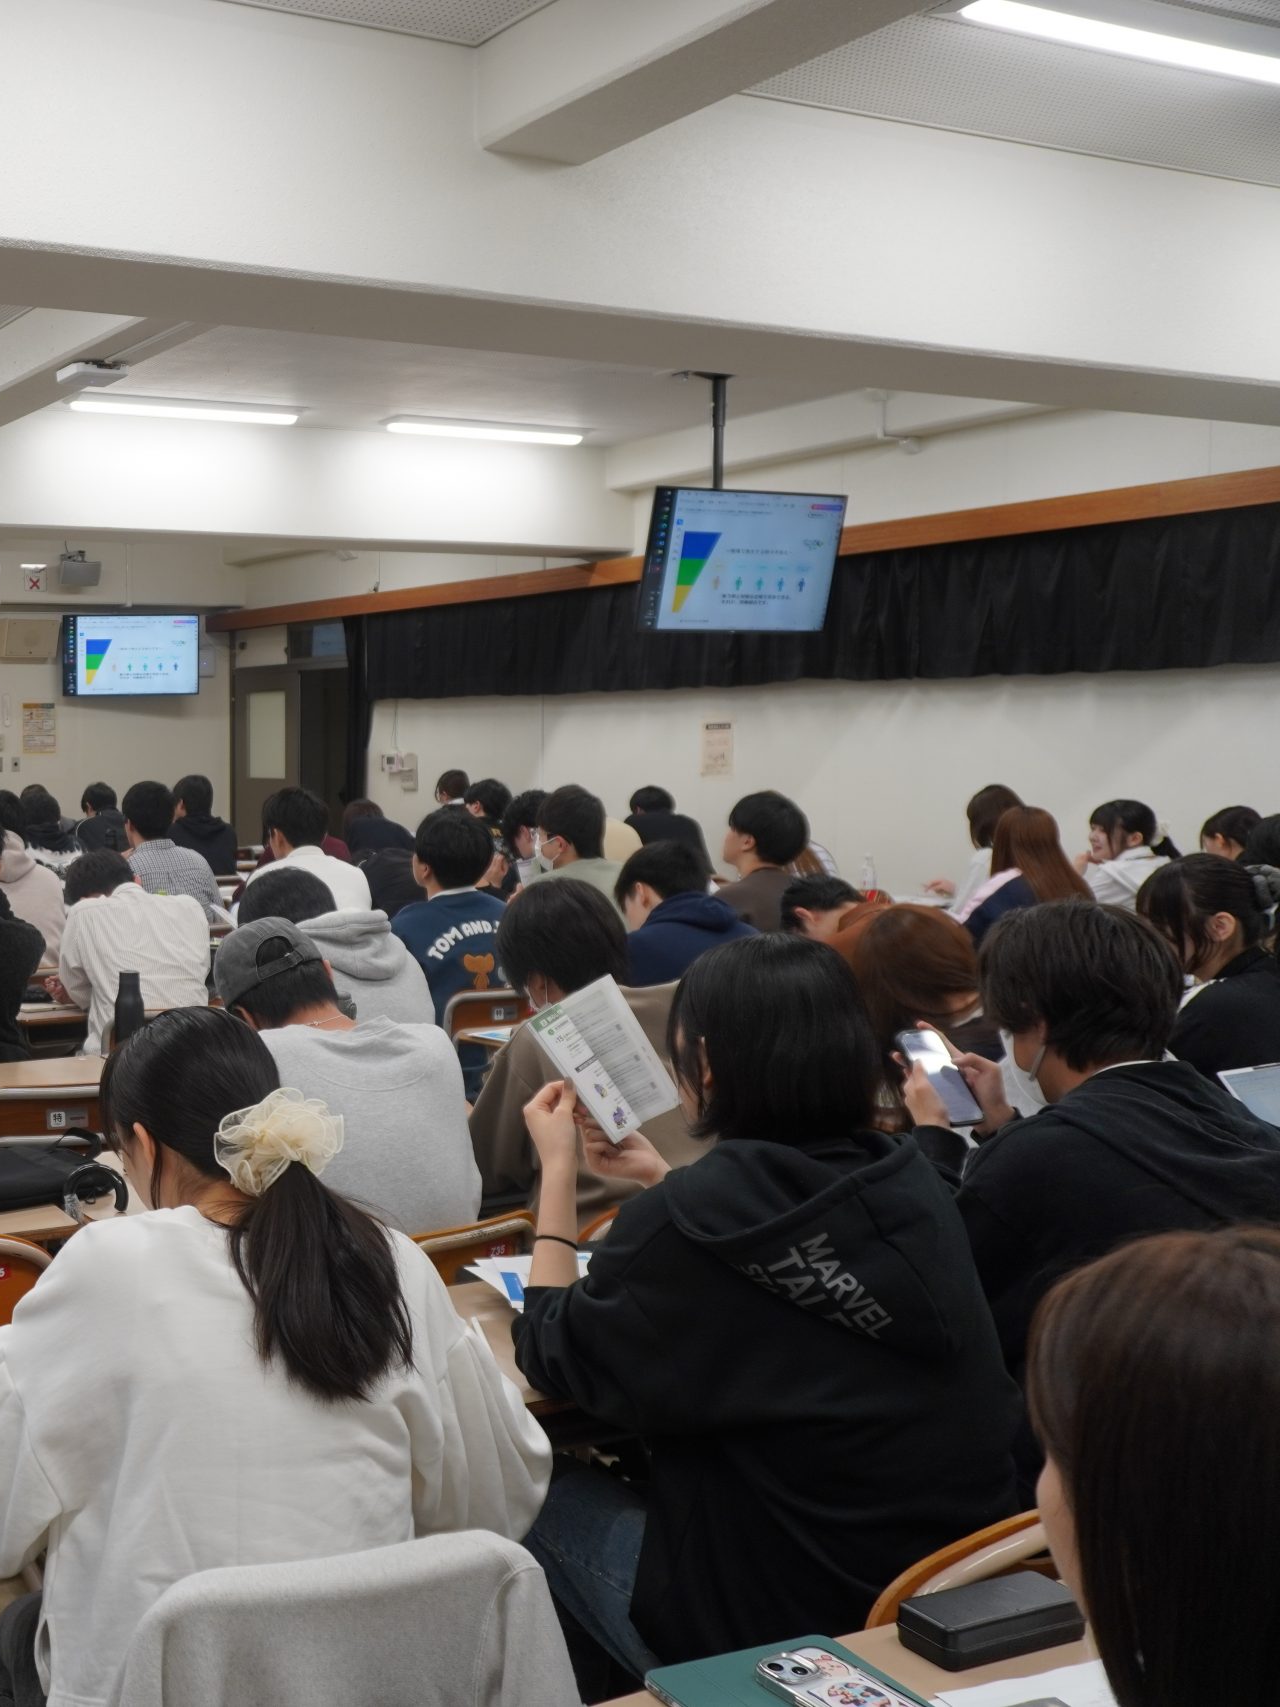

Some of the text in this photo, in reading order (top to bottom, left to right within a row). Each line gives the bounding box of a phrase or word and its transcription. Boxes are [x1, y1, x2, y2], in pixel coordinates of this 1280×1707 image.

[427, 926, 464, 960] TOM
[461, 920, 493, 937] AND
[53, 1113, 63, 1123] 特
[490, 1245, 506, 1257] Z35
[799, 1232, 893, 1339] MARVEL
